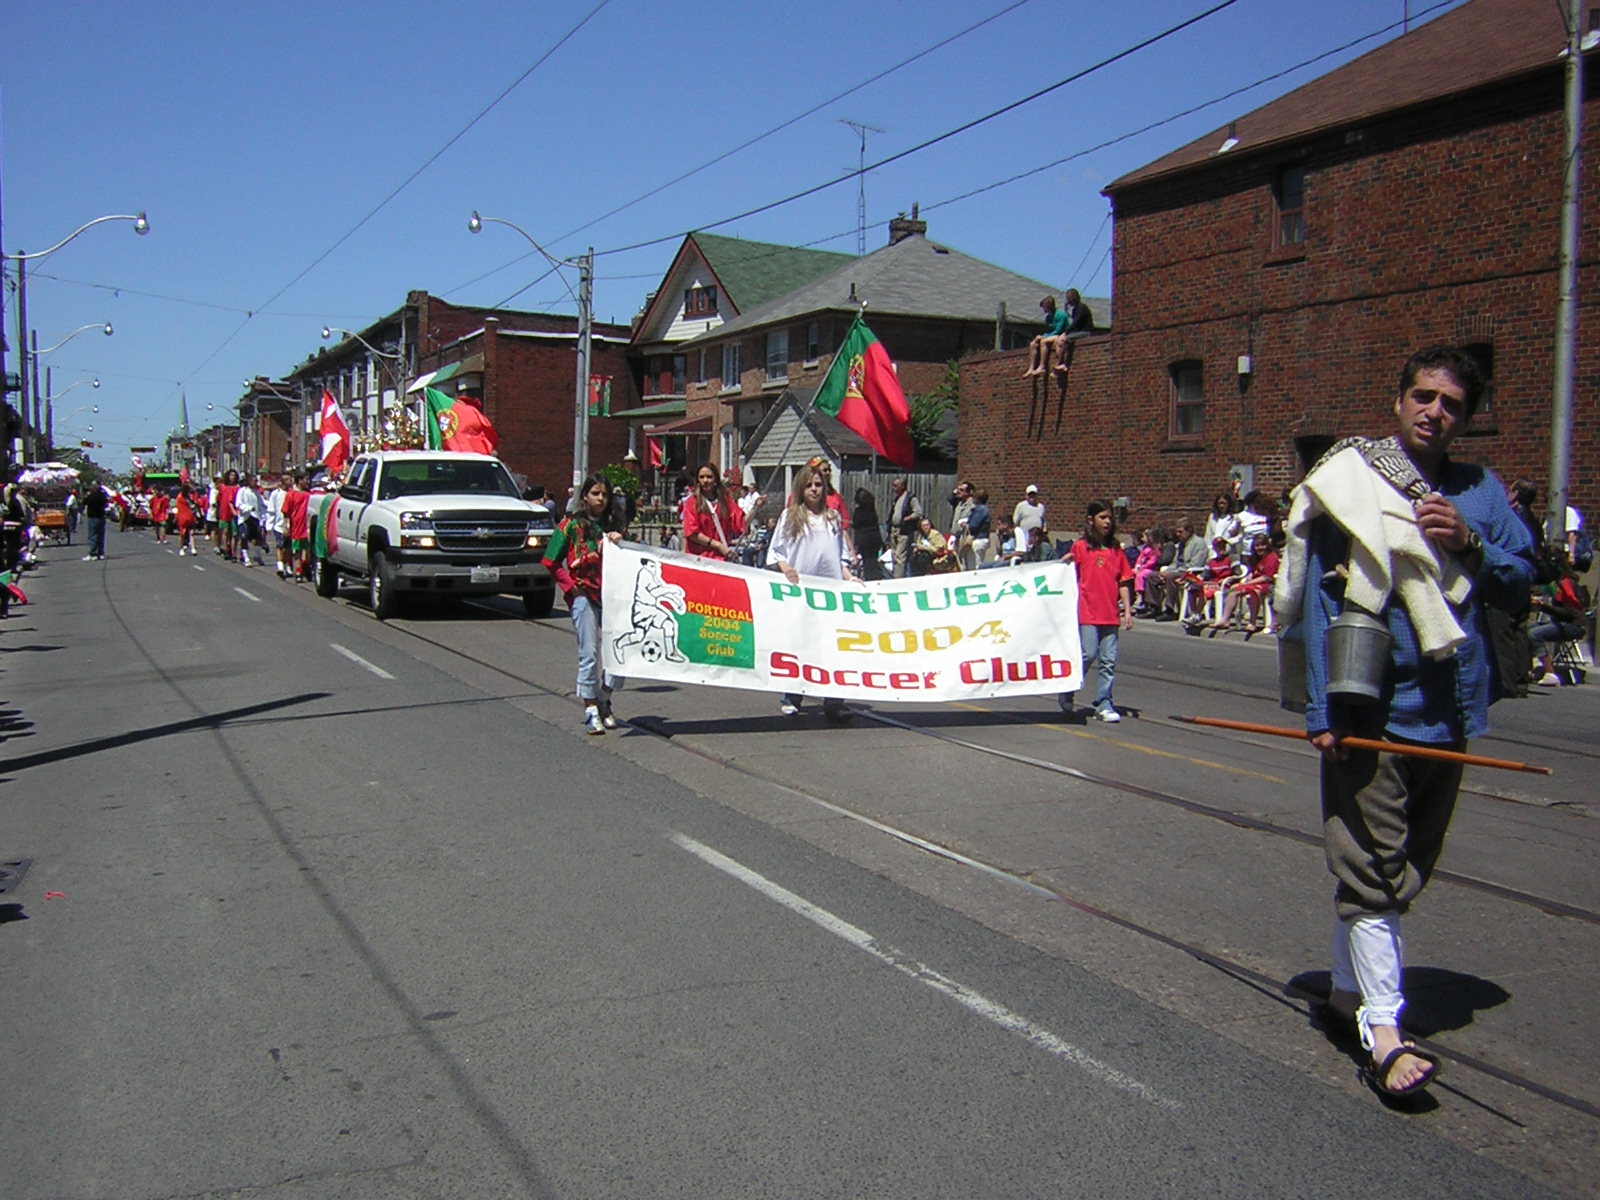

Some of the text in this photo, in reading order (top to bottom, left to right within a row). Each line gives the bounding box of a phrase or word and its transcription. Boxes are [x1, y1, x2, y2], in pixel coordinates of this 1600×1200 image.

[769, 575, 1063, 614] PORTUGAL
[687, 601, 753, 622] PORTUGAL
[704, 615, 740, 631] 2004
[700, 627, 742, 643] Soccer
[836, 620, 1011, 655] 2004
[706, 643, 735, 657] Club
[770, 651, 1072, 690] Soccer Club
